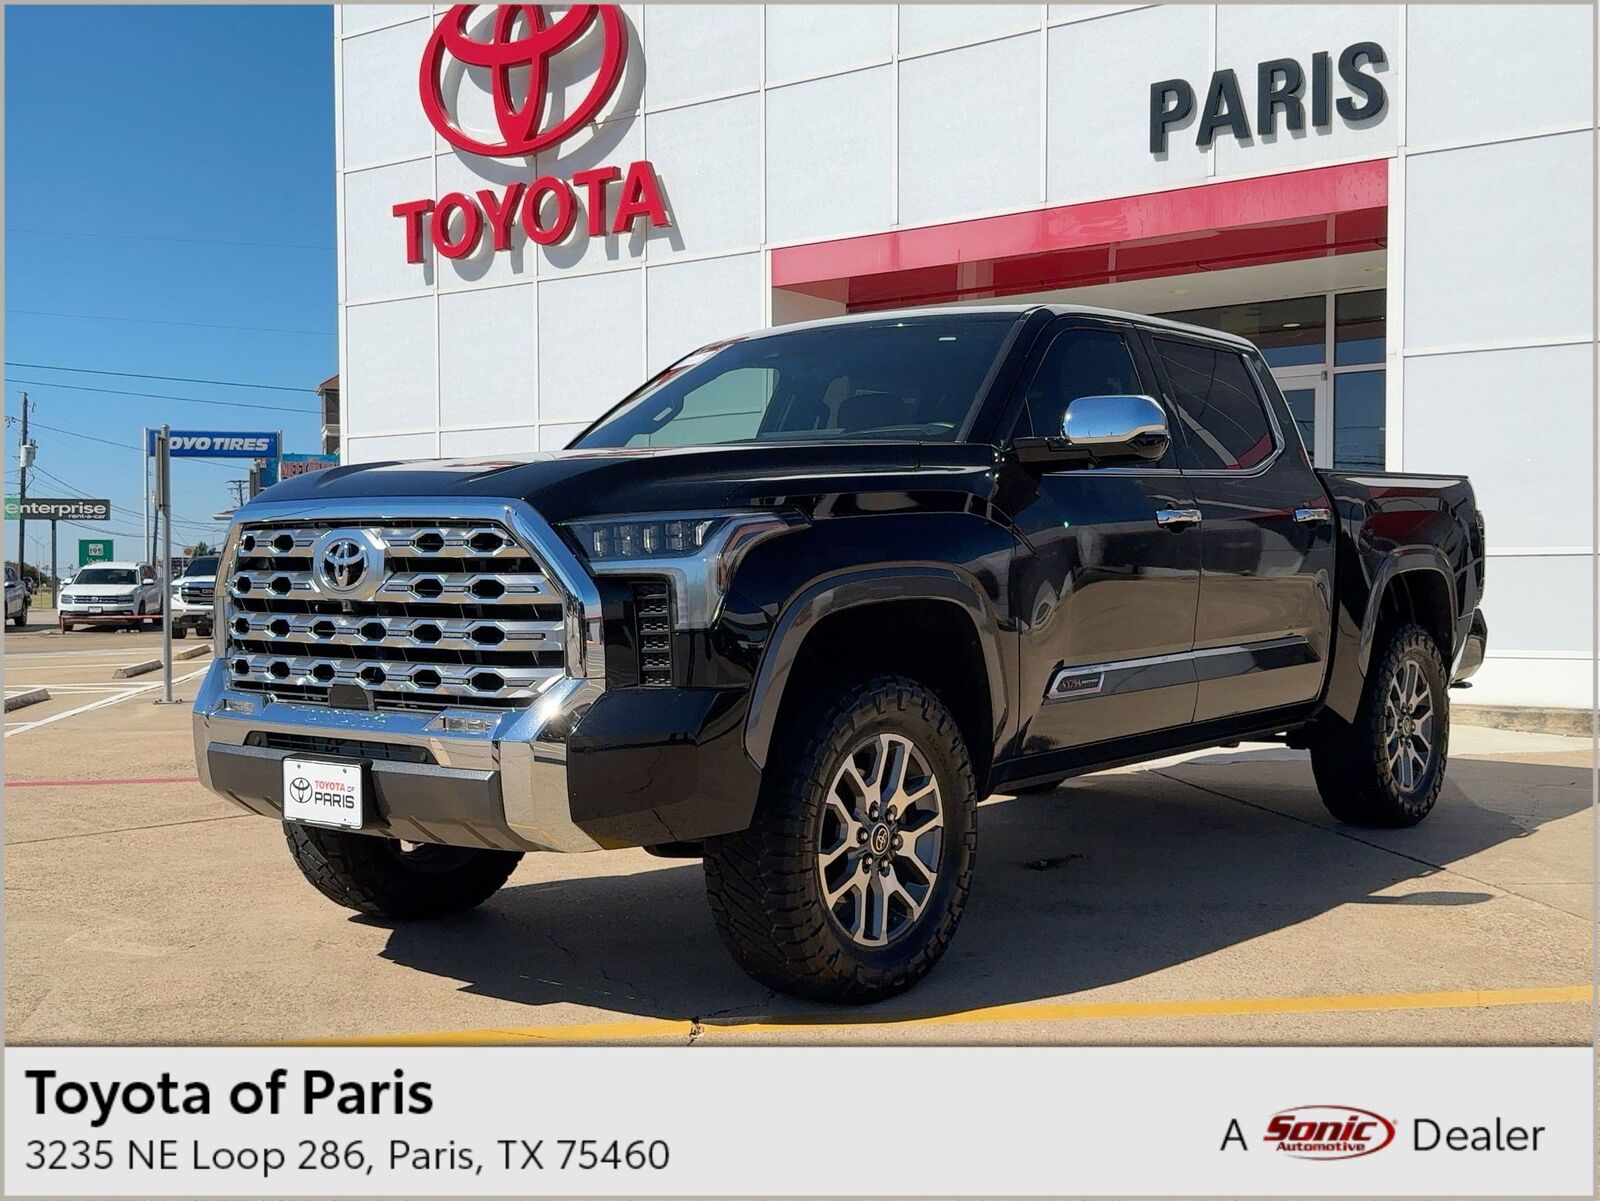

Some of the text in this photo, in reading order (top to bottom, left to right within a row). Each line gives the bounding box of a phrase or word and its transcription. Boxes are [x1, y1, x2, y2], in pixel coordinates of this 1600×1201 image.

[1149, 41, 1386, 154] PARIS
[393, 160, 672, 265] TOYOTA
[168, 436, 270, 452] OYO TIRES
[5, 501, 107, 517] enterprise
[314, 780, 346, 792] TOYOTA
[314, 791, 355, 809] PARIS
